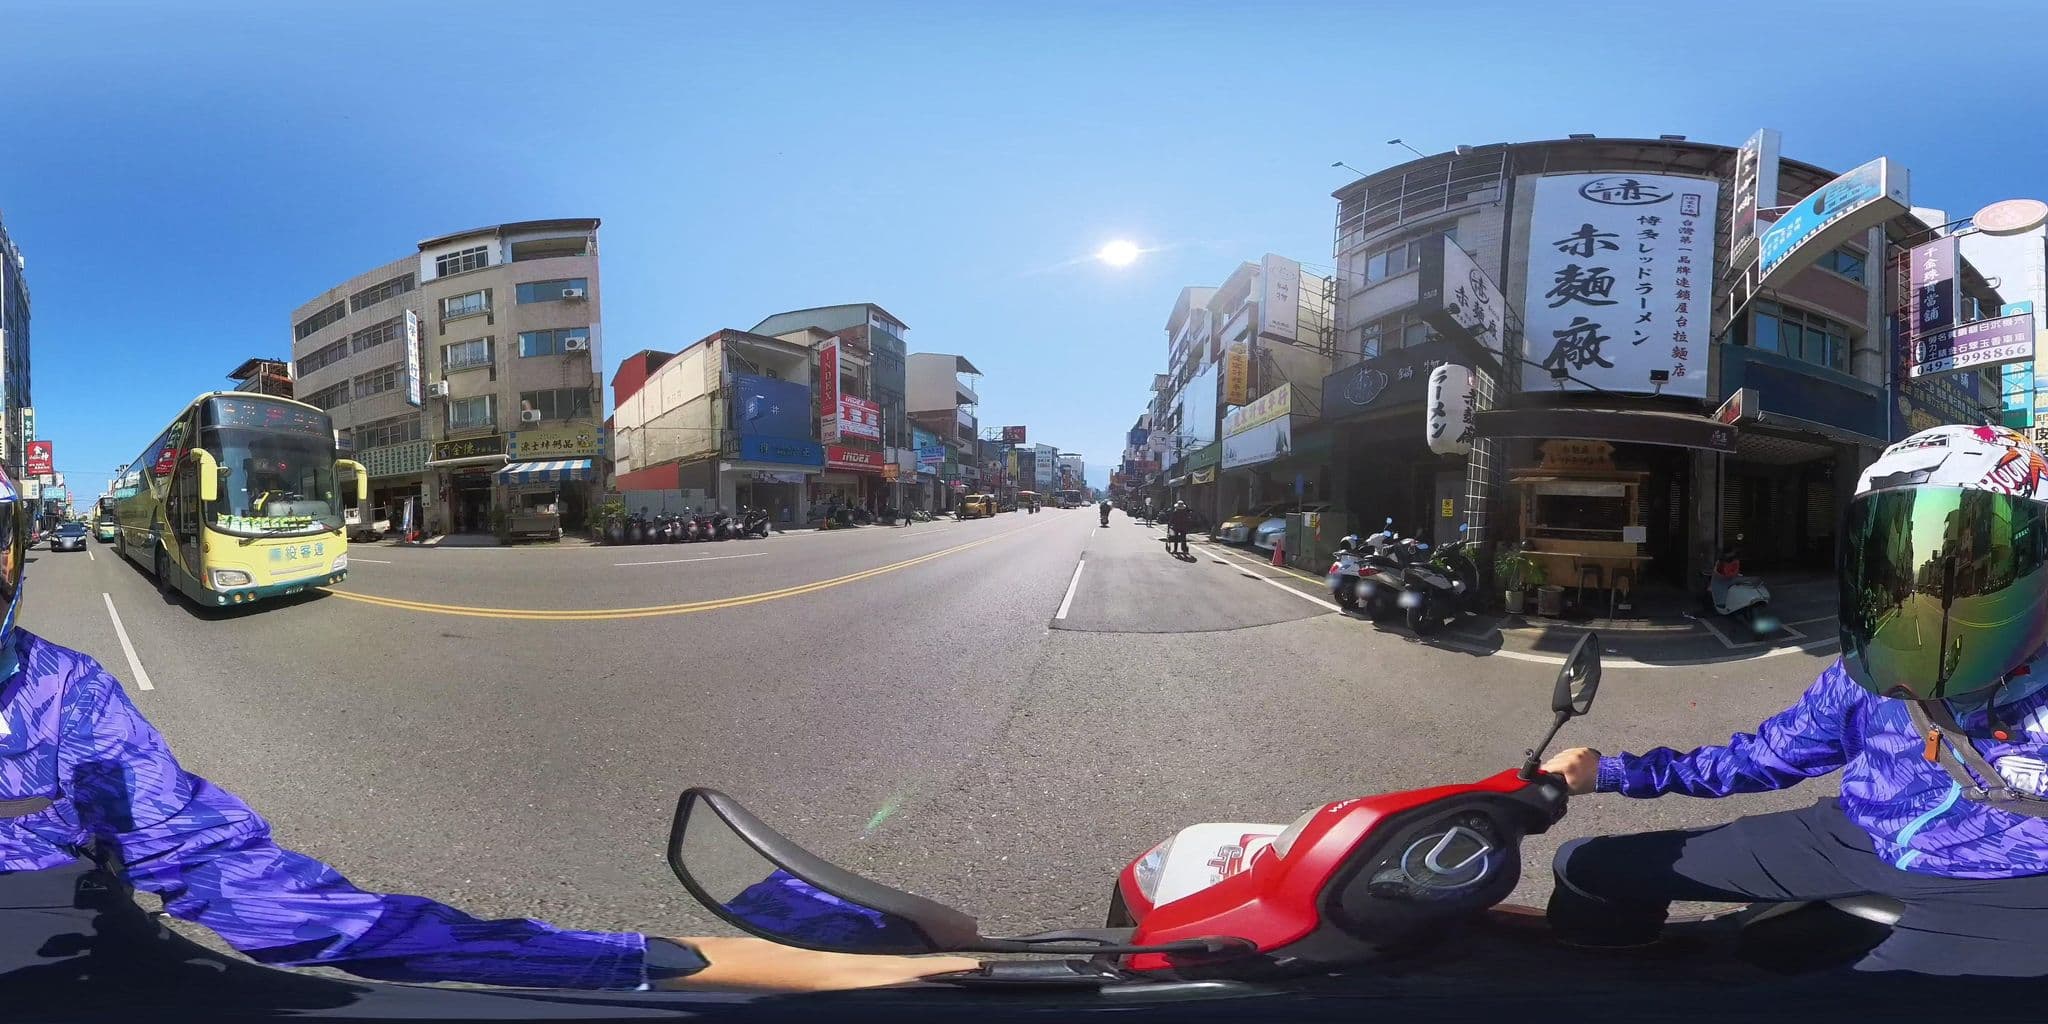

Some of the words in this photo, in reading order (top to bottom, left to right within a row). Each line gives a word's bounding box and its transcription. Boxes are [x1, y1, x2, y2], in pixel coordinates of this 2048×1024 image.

[1543, 223, 1620, 371] 赤麵廠
[1632, 215, 1663, 347] 博多レッドラーメン
[1431, 369, 1448, 439] ラーメン
[1917, 344, 2026, 375] 049-2998866
